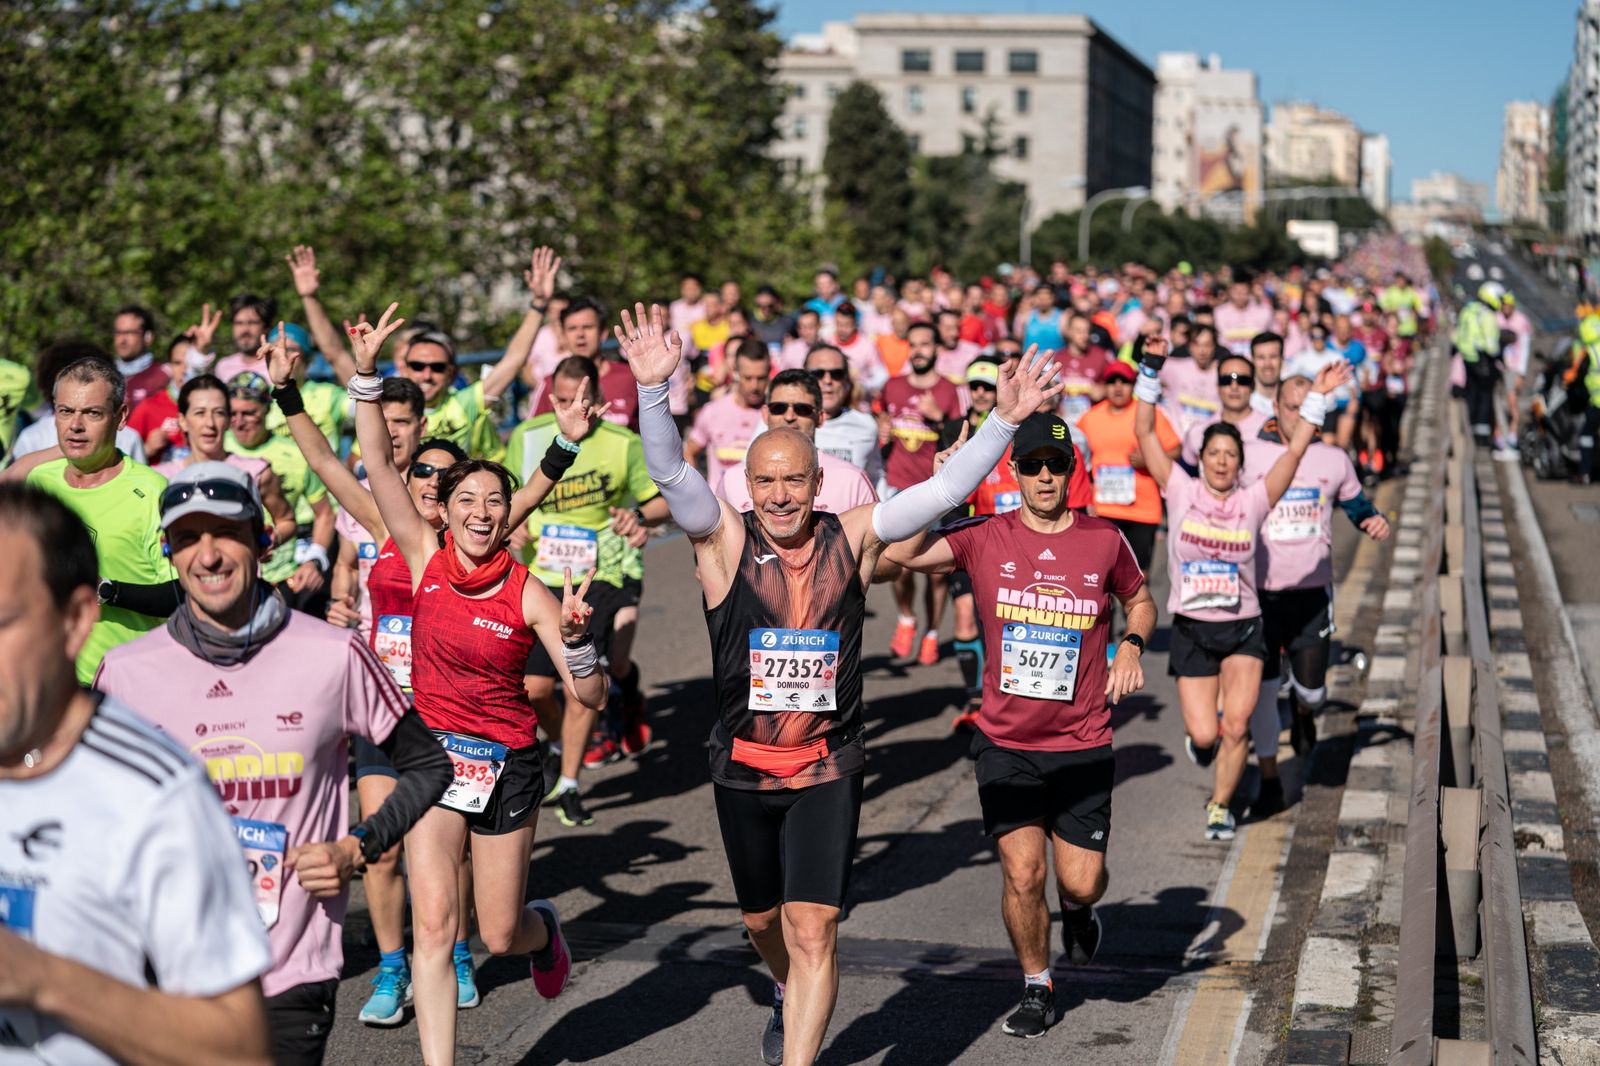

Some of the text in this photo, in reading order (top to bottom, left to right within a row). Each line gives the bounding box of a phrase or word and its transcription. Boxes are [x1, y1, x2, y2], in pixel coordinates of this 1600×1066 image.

[472, 616, 514, 636] BCTEAM
[782, 635, 826, 646] ZURICH
[1030, 630, 1069, 642] ZURICH
[1018, 649, 1060, 669] 5677
[764, 658, 823, 678] 27352
[1031, 670, 1044, 678] LUIS
[777, 681, 810, 689] DOMINGO
[212, 722, 246, 732] ZURICH
[451, 743, 493, 756] ZURICH
[206, 752, 304, 802] DRID
[451, 759, 488, 782] 333
